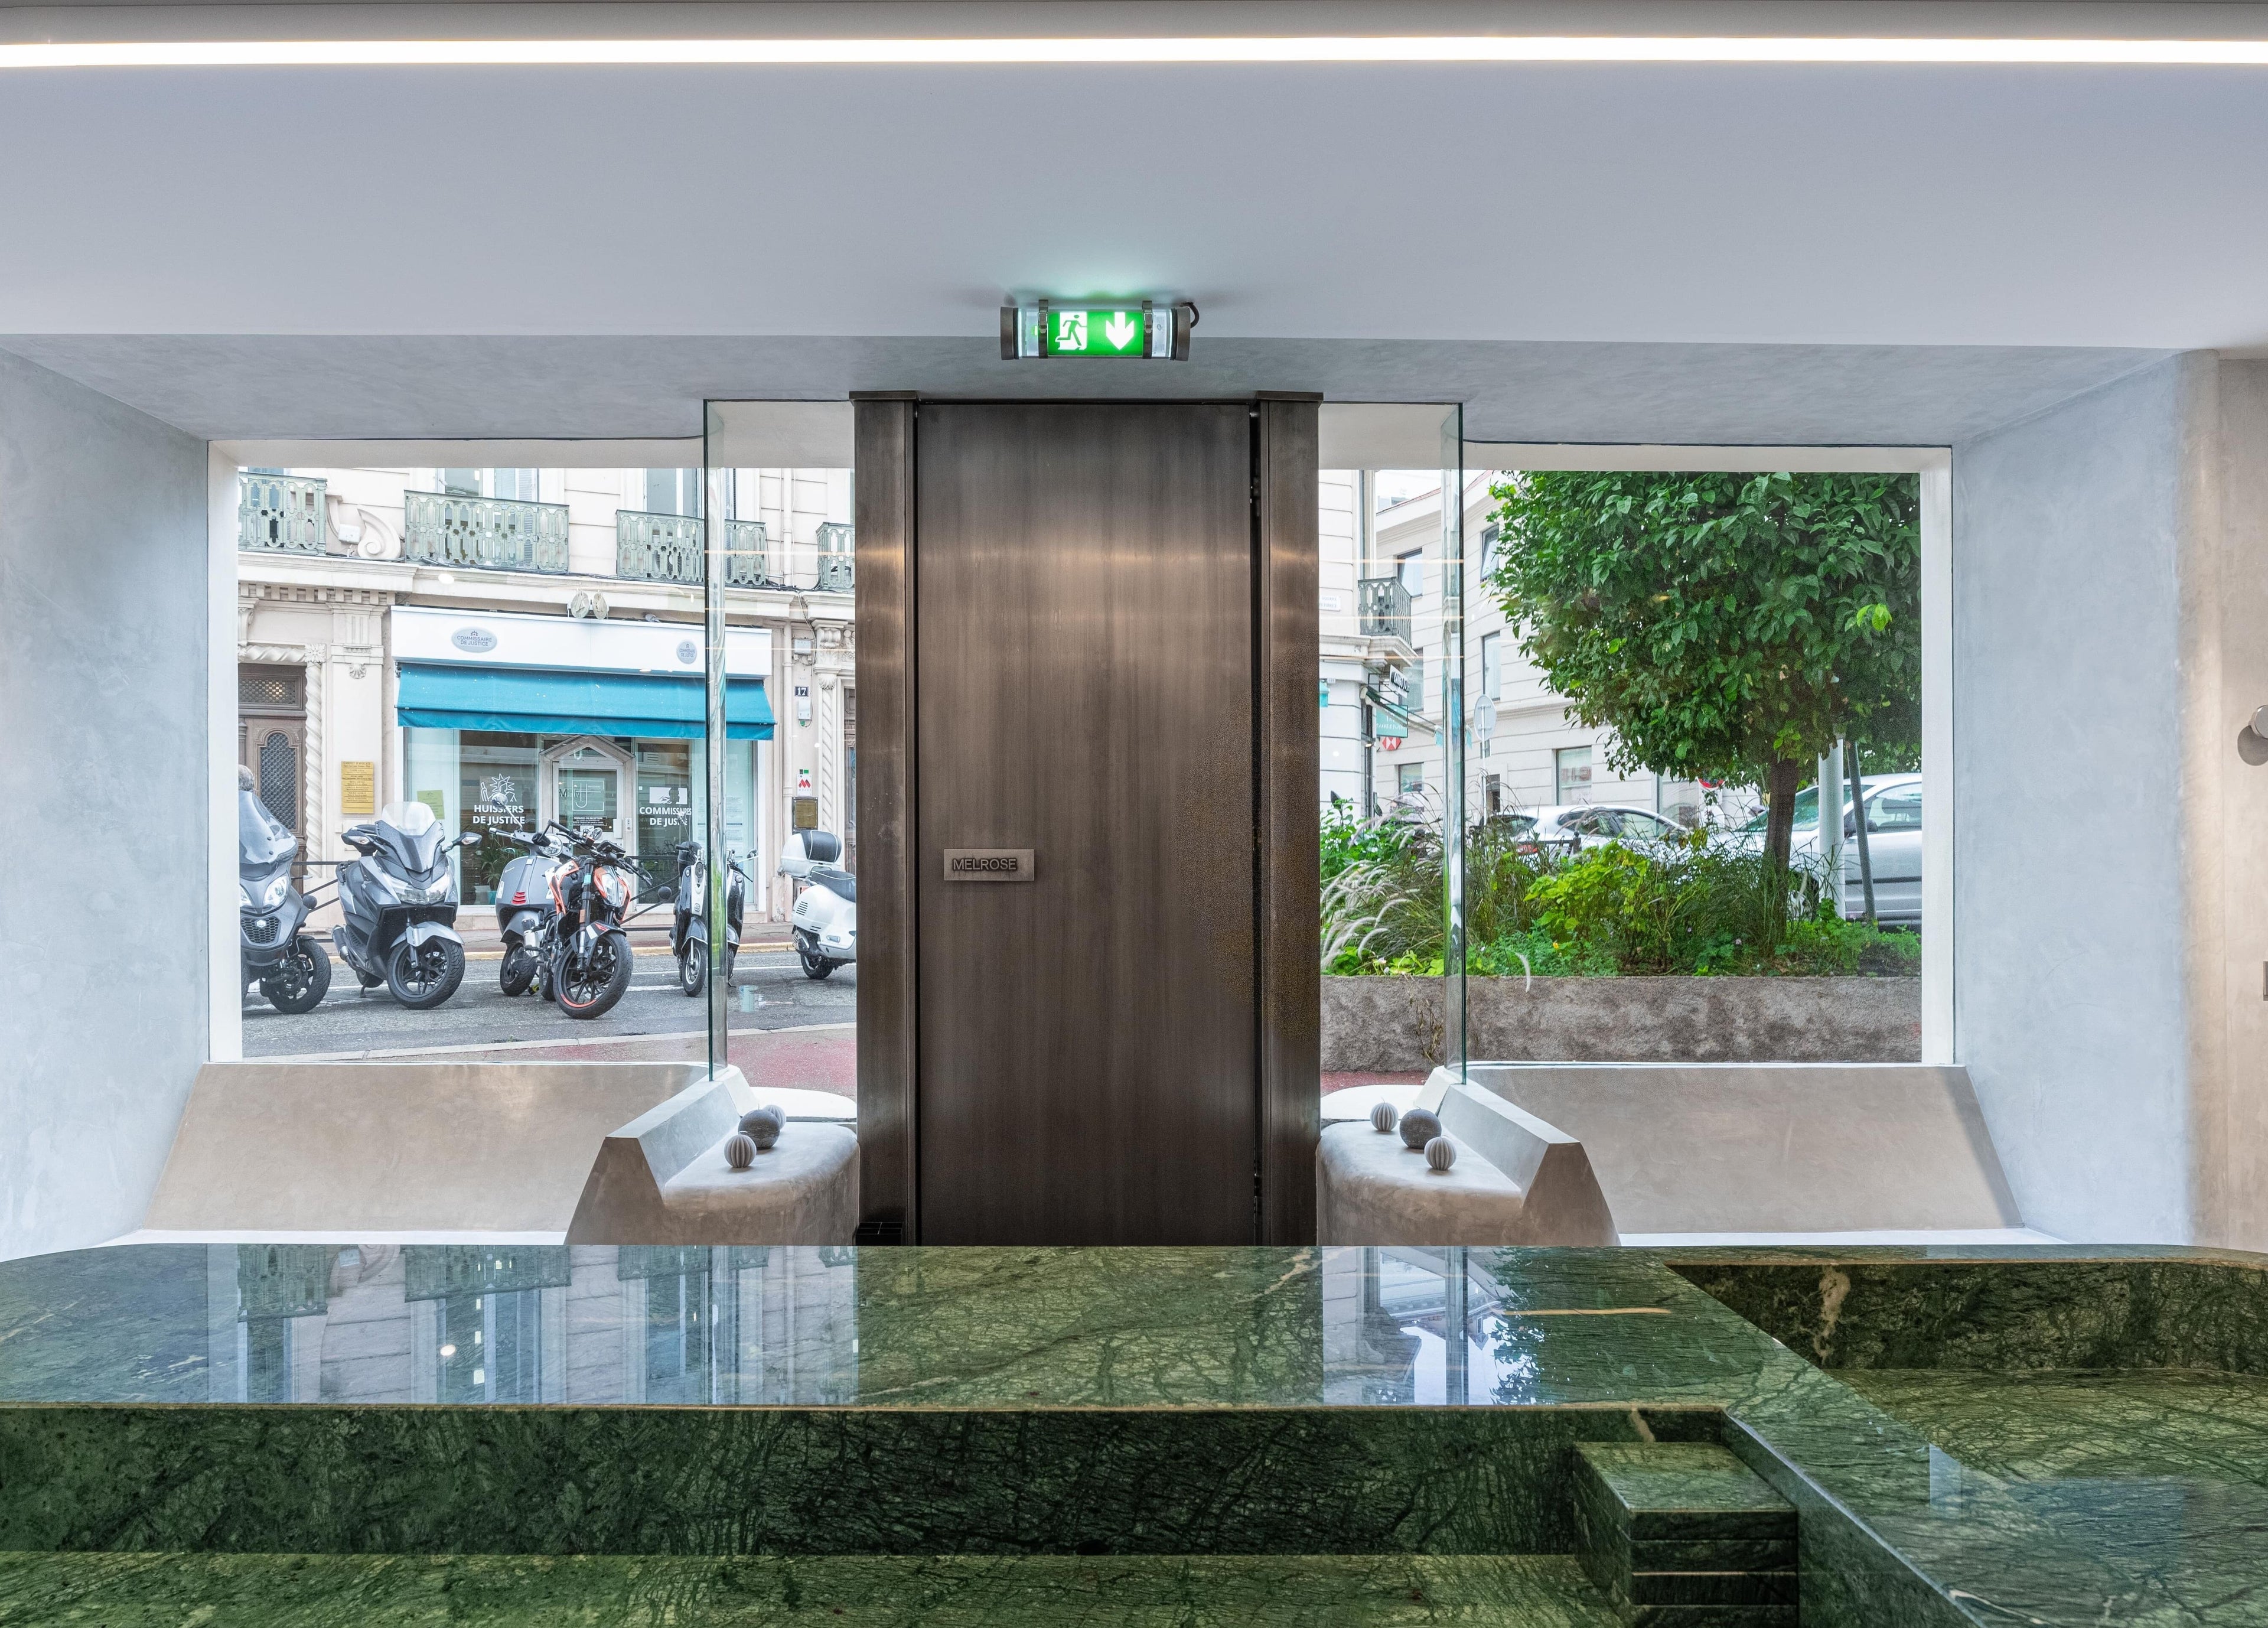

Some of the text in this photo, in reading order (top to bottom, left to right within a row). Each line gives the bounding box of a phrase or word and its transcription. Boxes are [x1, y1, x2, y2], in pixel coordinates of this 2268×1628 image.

[797, 687, 807, 696] 17
[472, 816, 525, 826] DE JUSTICE
[650, 818, 662, 826] DE
[953, 859, 1017, 871] MELROSE
